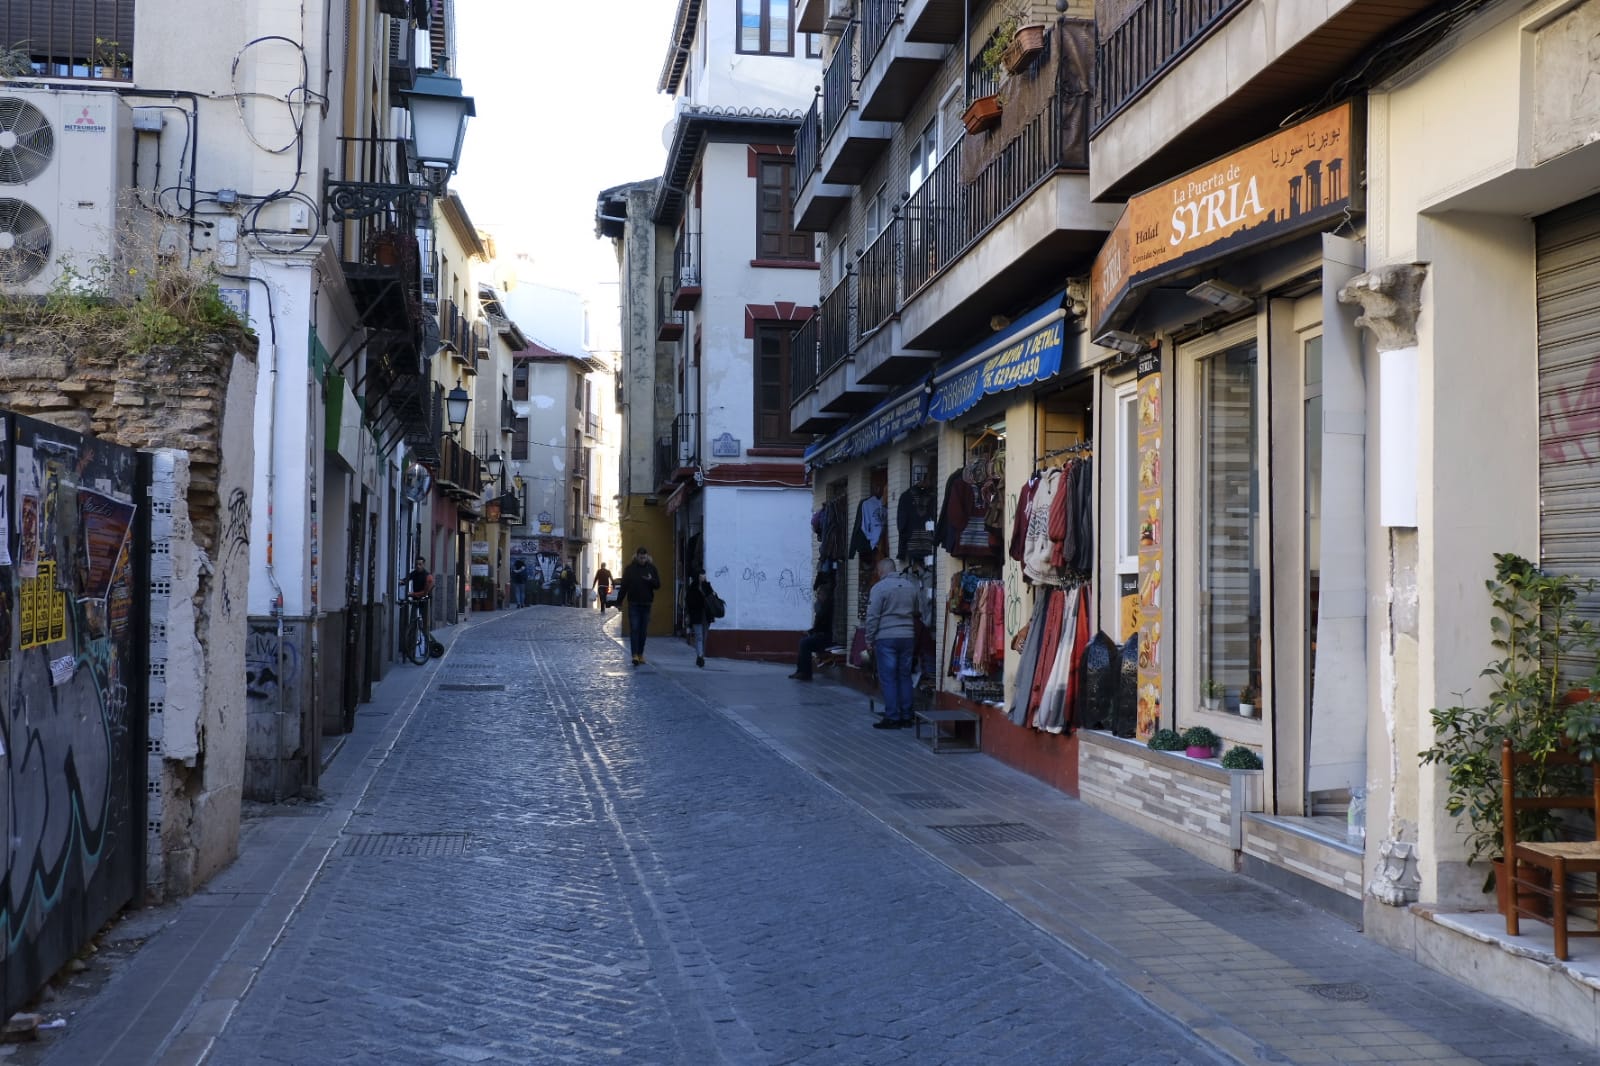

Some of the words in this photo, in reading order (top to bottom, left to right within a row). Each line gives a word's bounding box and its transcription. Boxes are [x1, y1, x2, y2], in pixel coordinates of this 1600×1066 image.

[1271, 145, 1304, 169] سوريا
[1173, 188, 1186, 205] La
[1188, 173, 1224, 199] Puerta
[1226, 164, 1240, 182] de
[1170, 175, 1265, 246] SYRIA
[1135, 222, 1160, 245] Halal
[1152, 246, 1167, 260] Syria
[1031, 324, 1061, 355] DETALL
